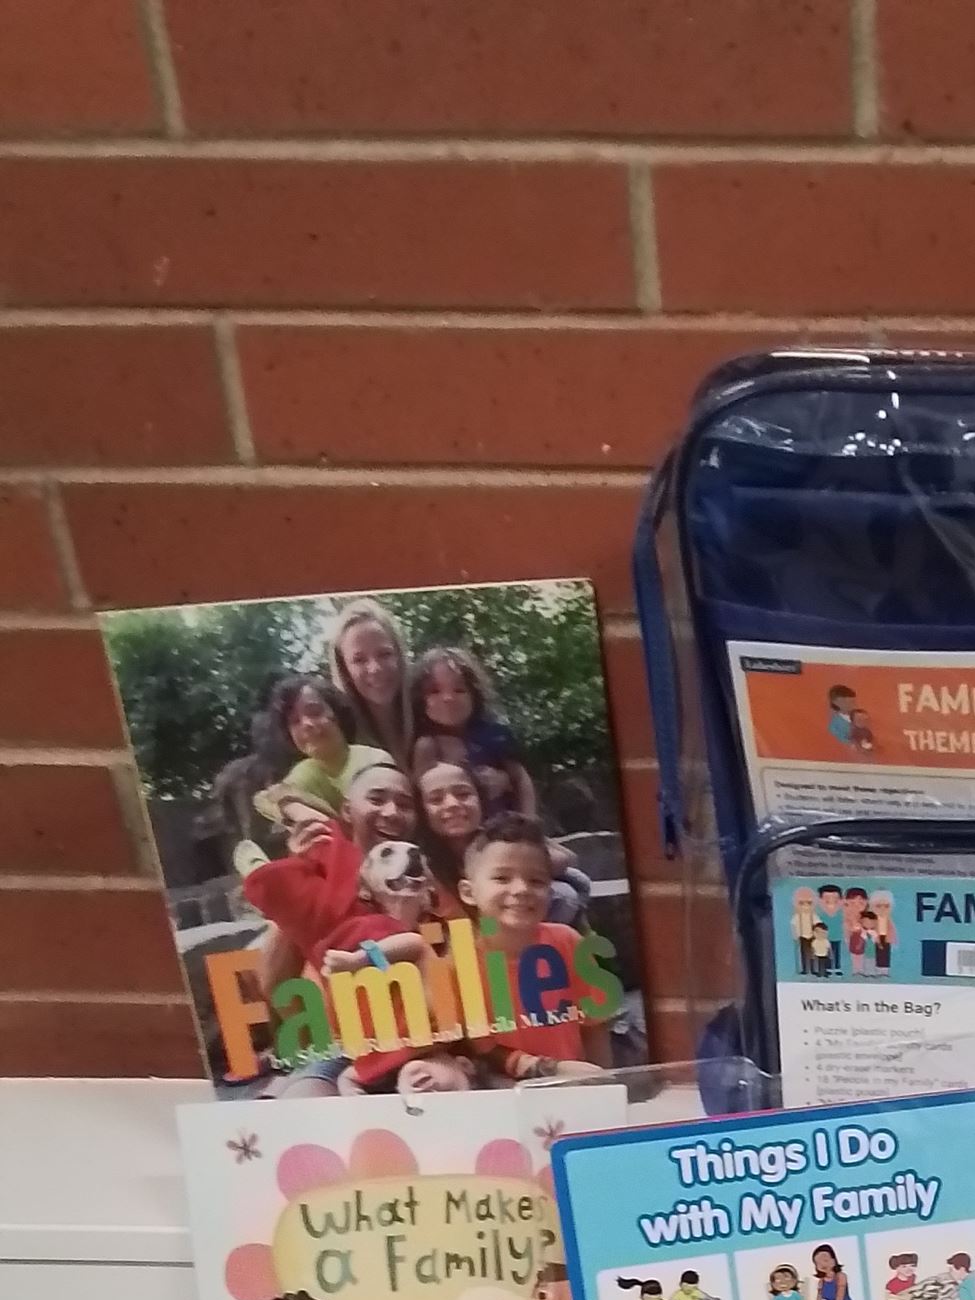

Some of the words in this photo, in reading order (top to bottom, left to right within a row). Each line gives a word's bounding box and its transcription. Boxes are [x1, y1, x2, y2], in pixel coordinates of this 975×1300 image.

[205, 917, 624, 1080] Families
[801, 1000, 852, 1013] What's
[856, 1001, 870, 1013] in
[875, 1002, 899, 1013] the
[904, 1002, 941, 1017] Bag?
[671, 1141, 807, 1184] Things
[815, 1131, 829, 1167] I
[839, 1127, 897, 1165] Do
[299, 1185, 420, 1239] What
[445, 1188, 549, 1225] Makes
[640, 1200, 730, 1245] with
[741, 1193, 803, 1236] My
[812, 1172, 940, 1224] Family
[315, 1249, 358, 1294] a
[385, 1228, 556, 1293] Family?
